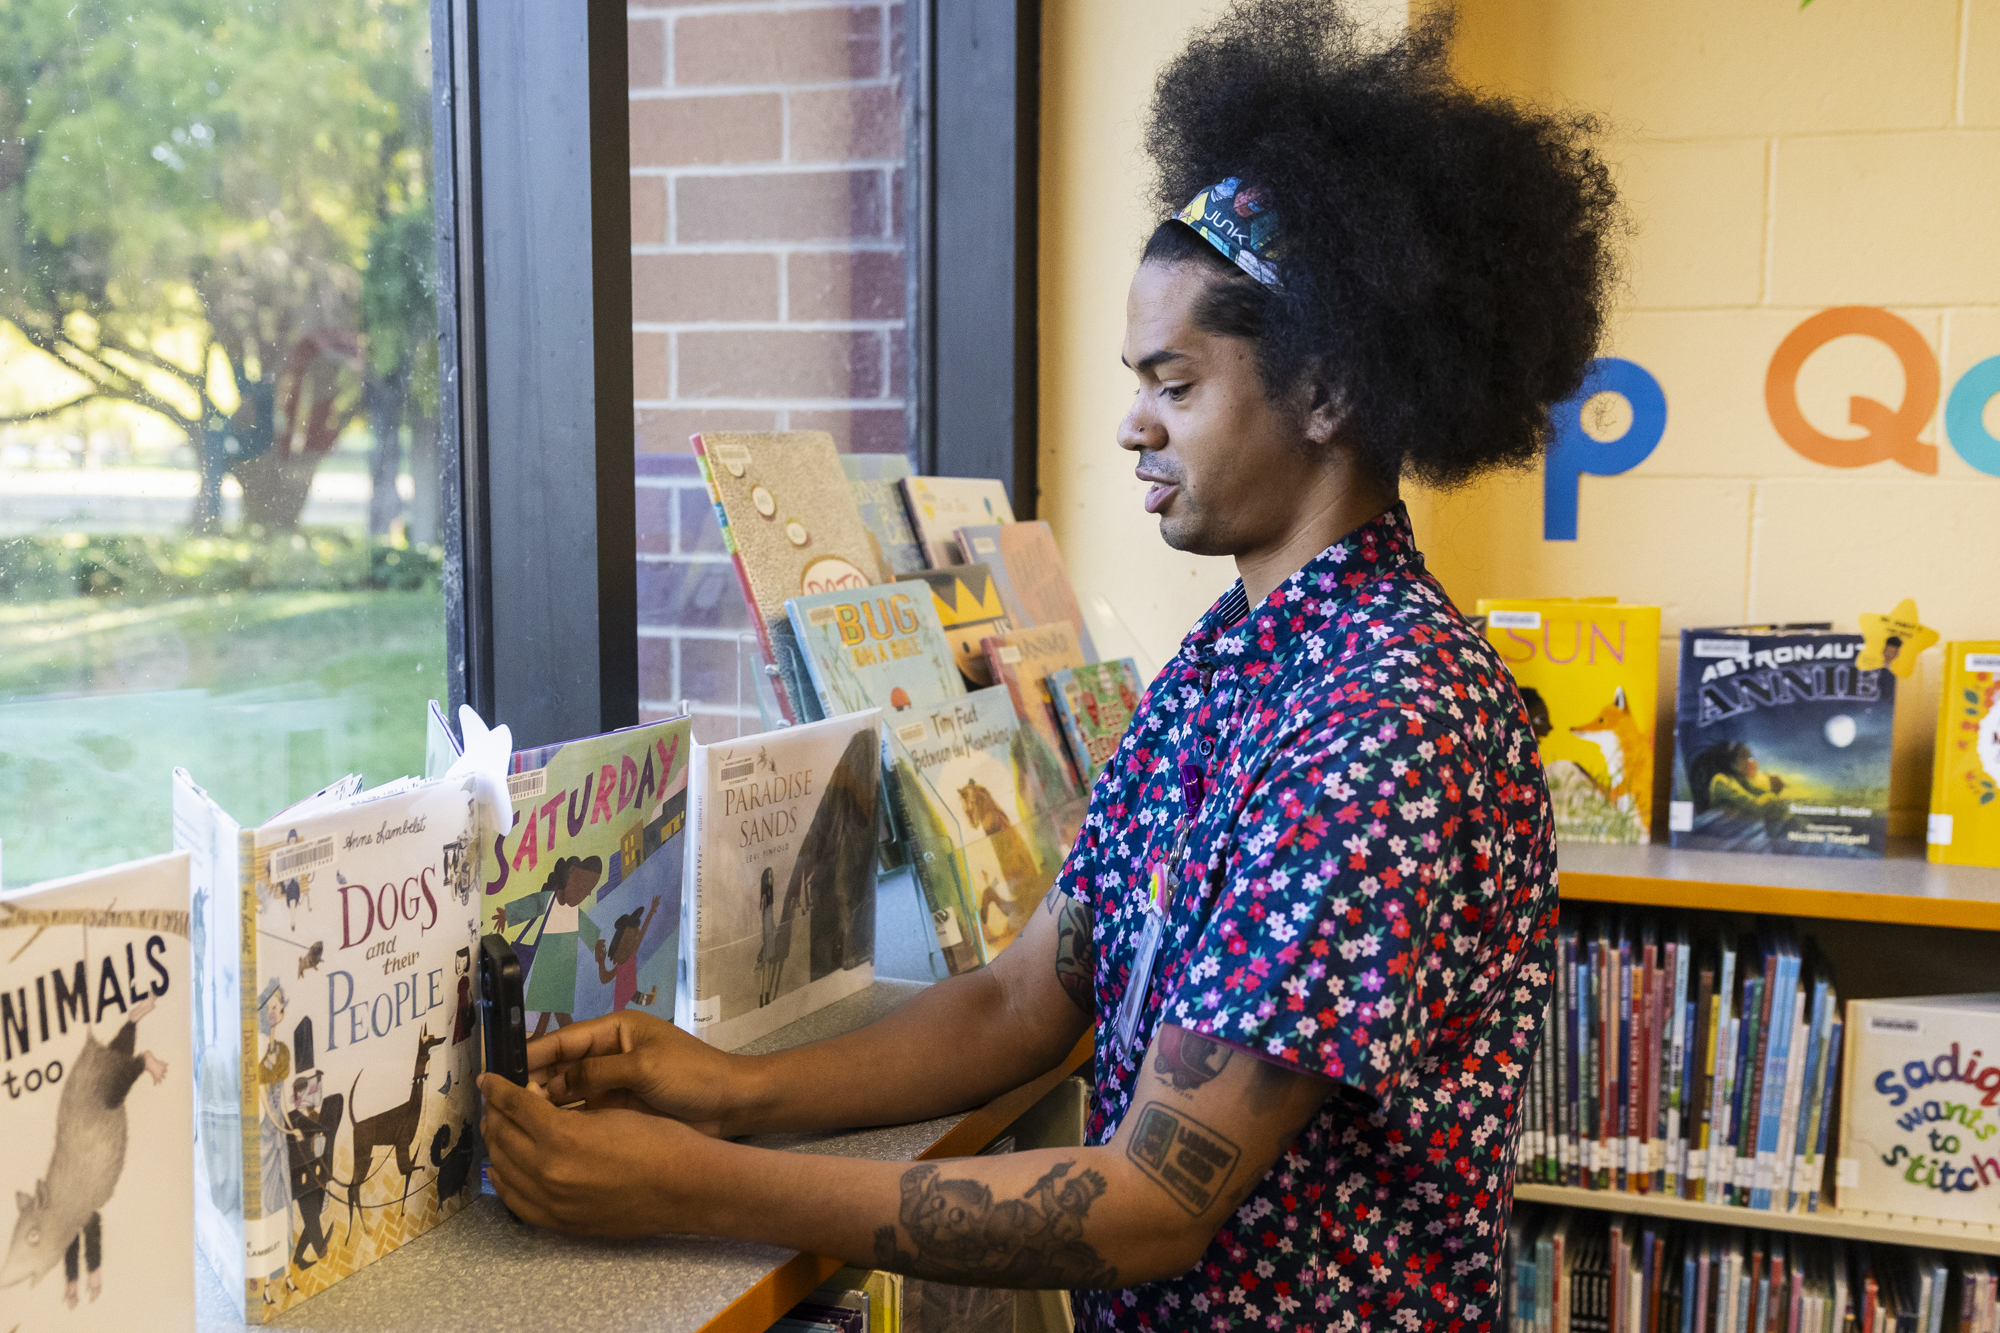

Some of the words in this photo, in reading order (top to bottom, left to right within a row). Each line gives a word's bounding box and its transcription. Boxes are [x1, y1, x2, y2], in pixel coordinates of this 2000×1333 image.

[1204, 210, 1249, 246] JUNK
[835, 593, 920, 646] BUG
[1503, 618, 1627, 666] SUN
[1697, 662, 1881, 728] ANNIE
[486, 733, 679, 896] SATURDAY
[725, 769, 813, 817] PARADISE
[343, 830, 373, 851] Anne
[375, 813, 427, 845] Lambelet
[740, 806, 798, 848] SANDS
[746, 853, 760, 863] LEVI
[763, 843, 789, 857] PINFOLD
[337, 863, 438, 951] DOGS
[366, 935, 398, 961] and
[382, 950, 420, 976] their
[326, 967, 445, 1053] PEOPLE
[2, 1060, 63, 1099] too
[1875, 1041, 2000, 1107] Sadiq
[1896, 1100, 1997, 1141] wants
[1928, 1128, 1961, 1154] to
[1882, 1145, 2000, 1194] stitch
